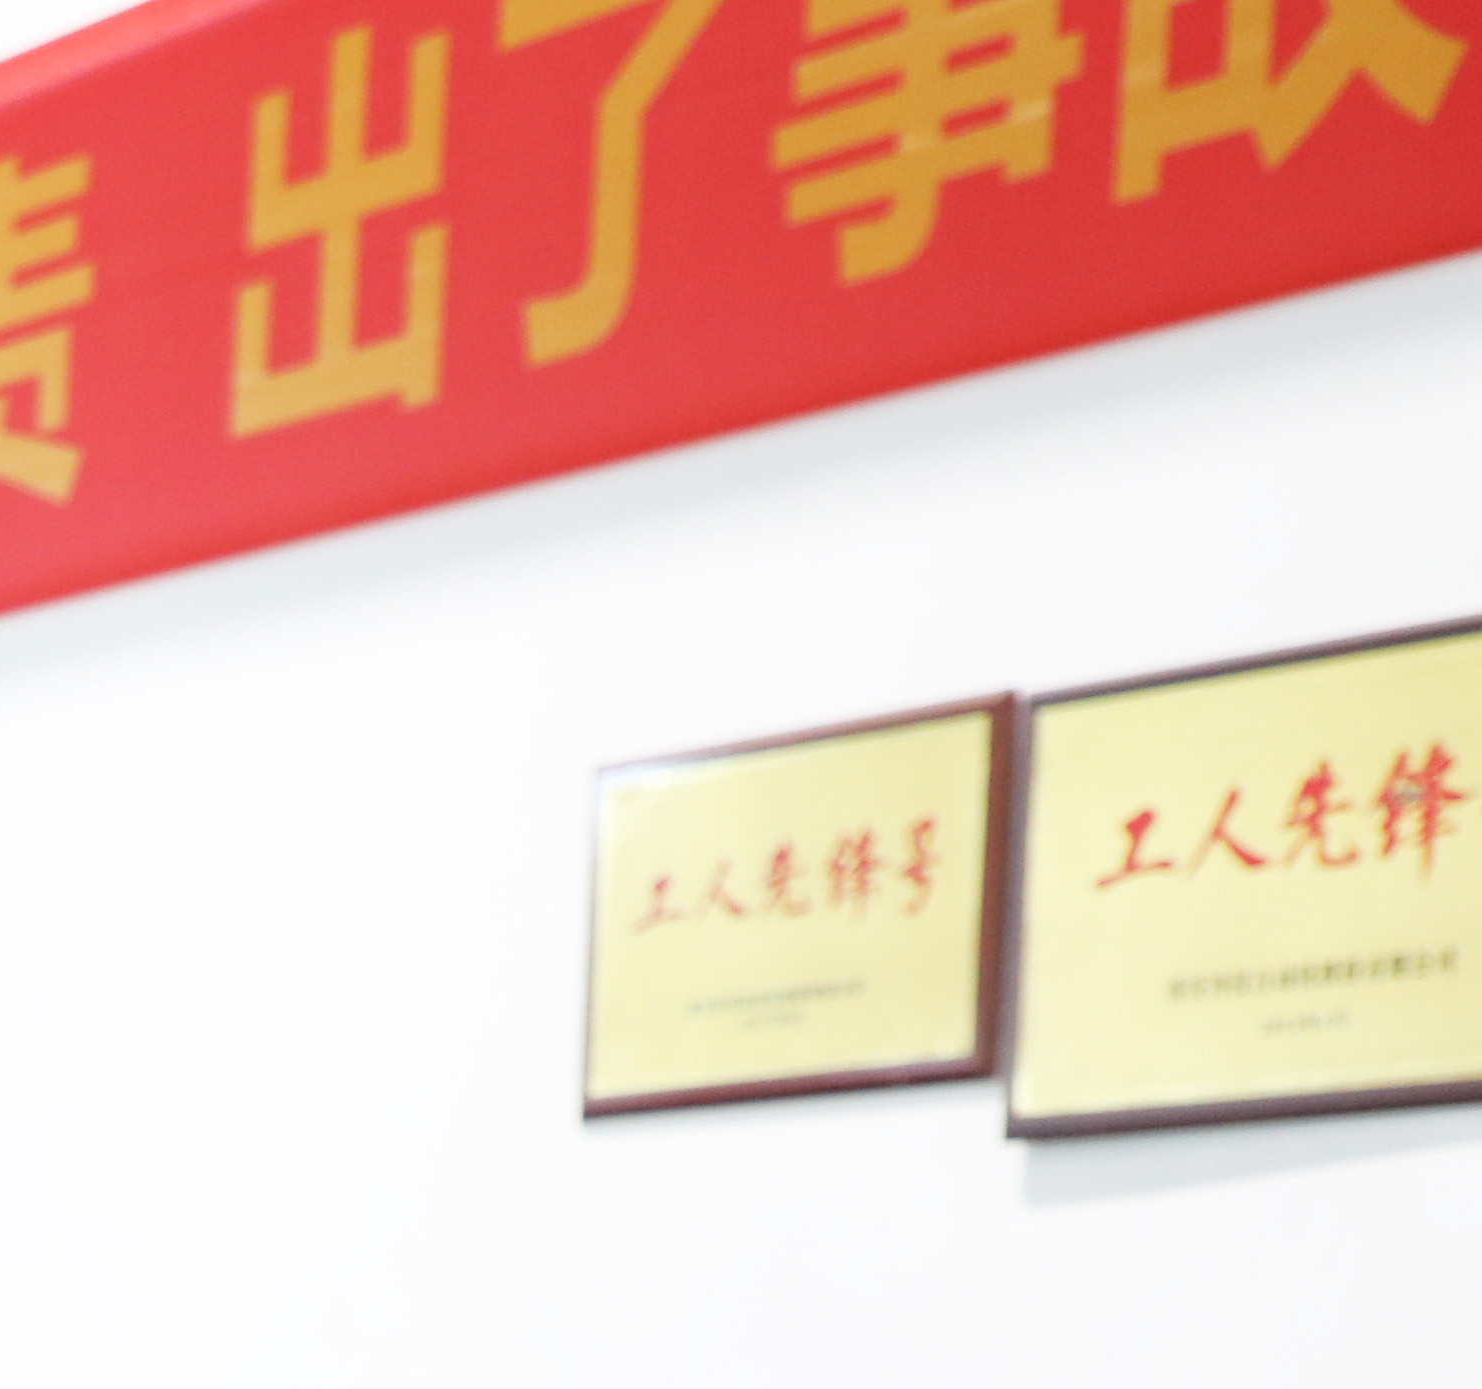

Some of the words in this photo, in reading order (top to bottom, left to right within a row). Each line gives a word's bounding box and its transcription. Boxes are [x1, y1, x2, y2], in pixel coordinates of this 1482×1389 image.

[630, 814, 940, 934] 工人先锋号
